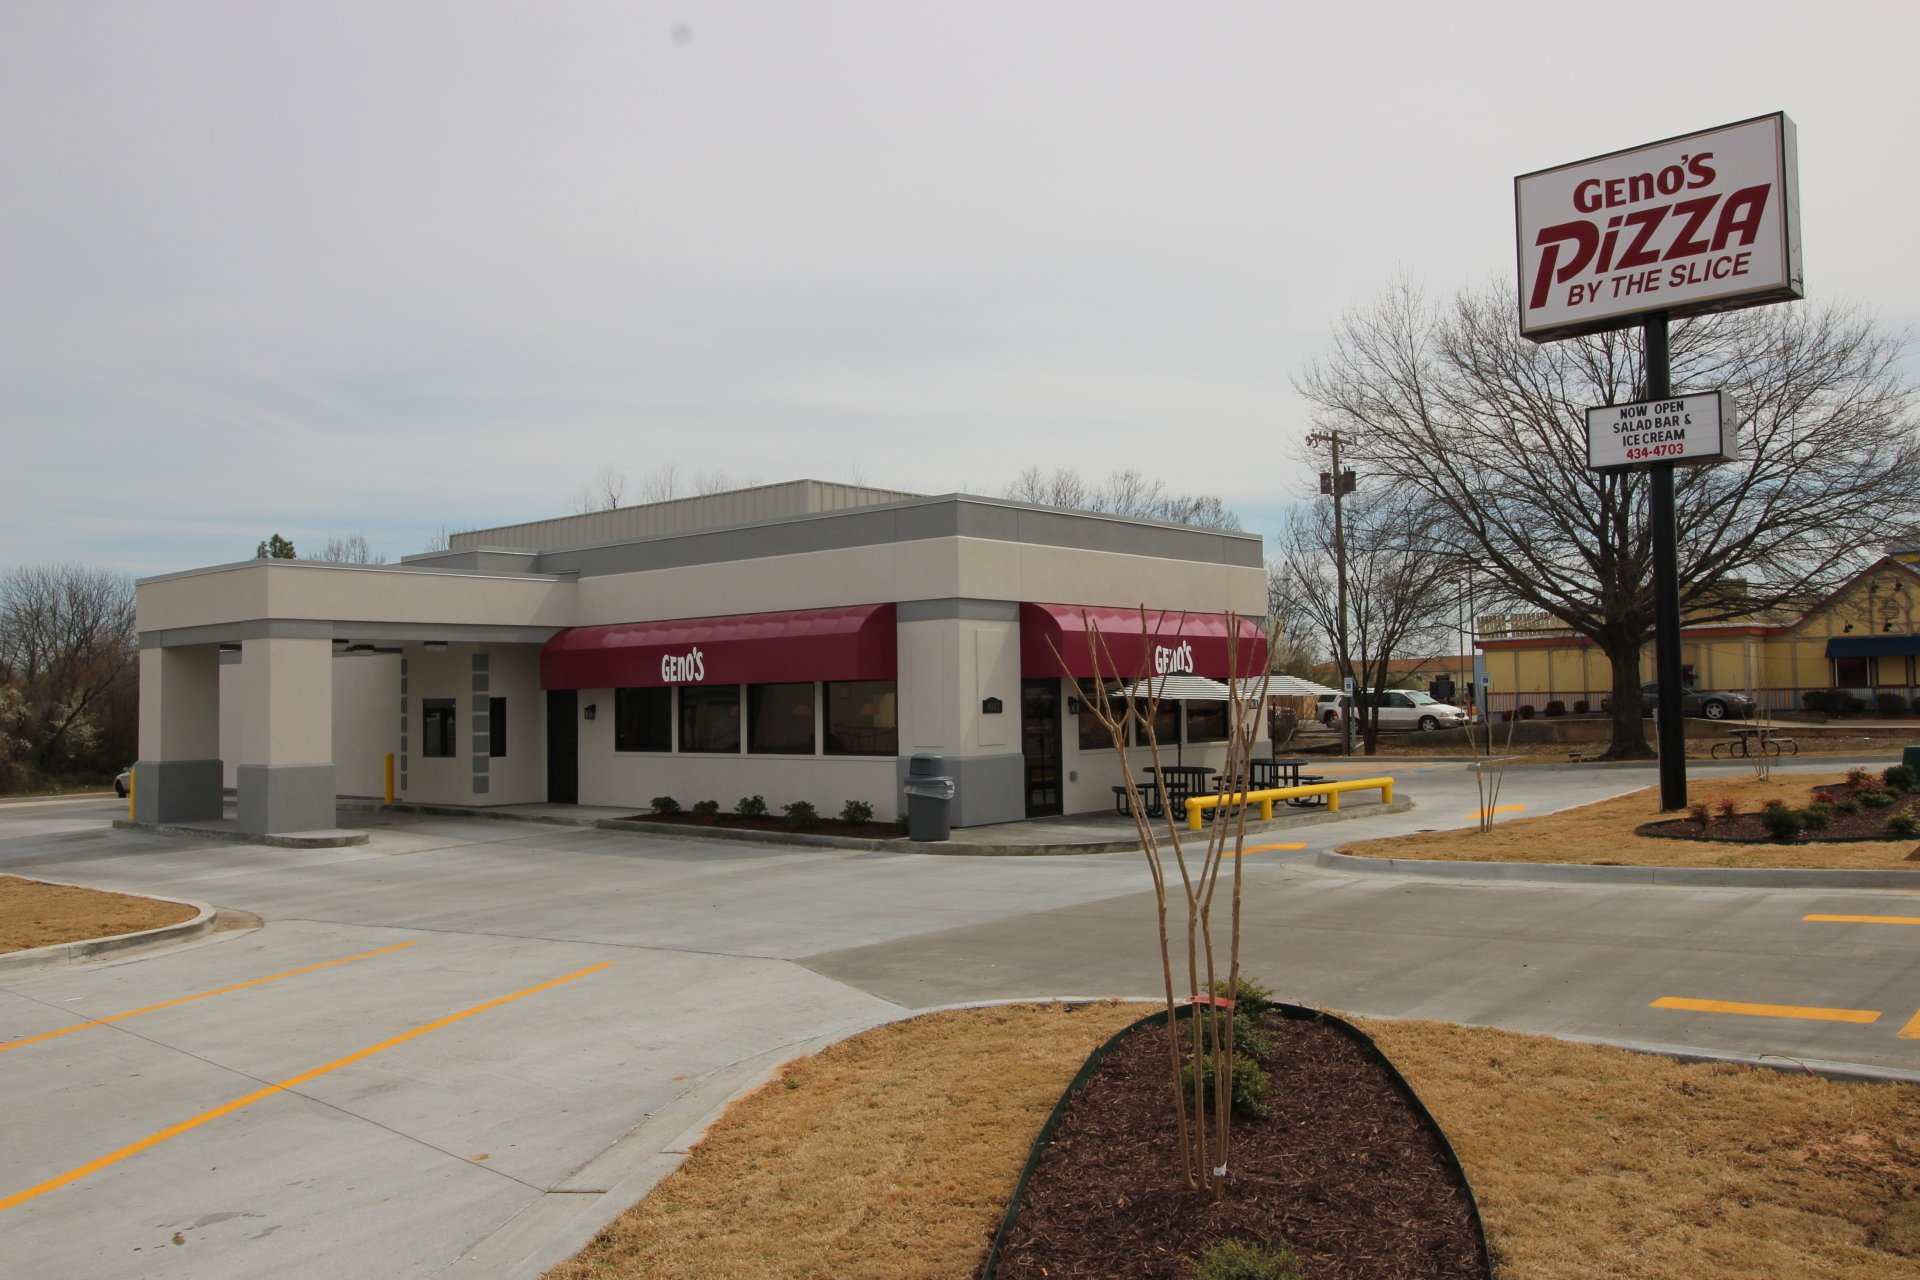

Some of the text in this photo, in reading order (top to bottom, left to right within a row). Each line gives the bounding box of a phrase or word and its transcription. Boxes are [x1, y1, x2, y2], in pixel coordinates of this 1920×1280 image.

[1567, 252, 1752, 307] BY THE SLICE
[1620, 400, 1684, 419] NOW OPEN
[1613, 413, 1692, 434] SALAD BAR &
[1622, 428, 1685, 447] ICE CREAM
[1626, 443, 1684, 460] 434-4703
